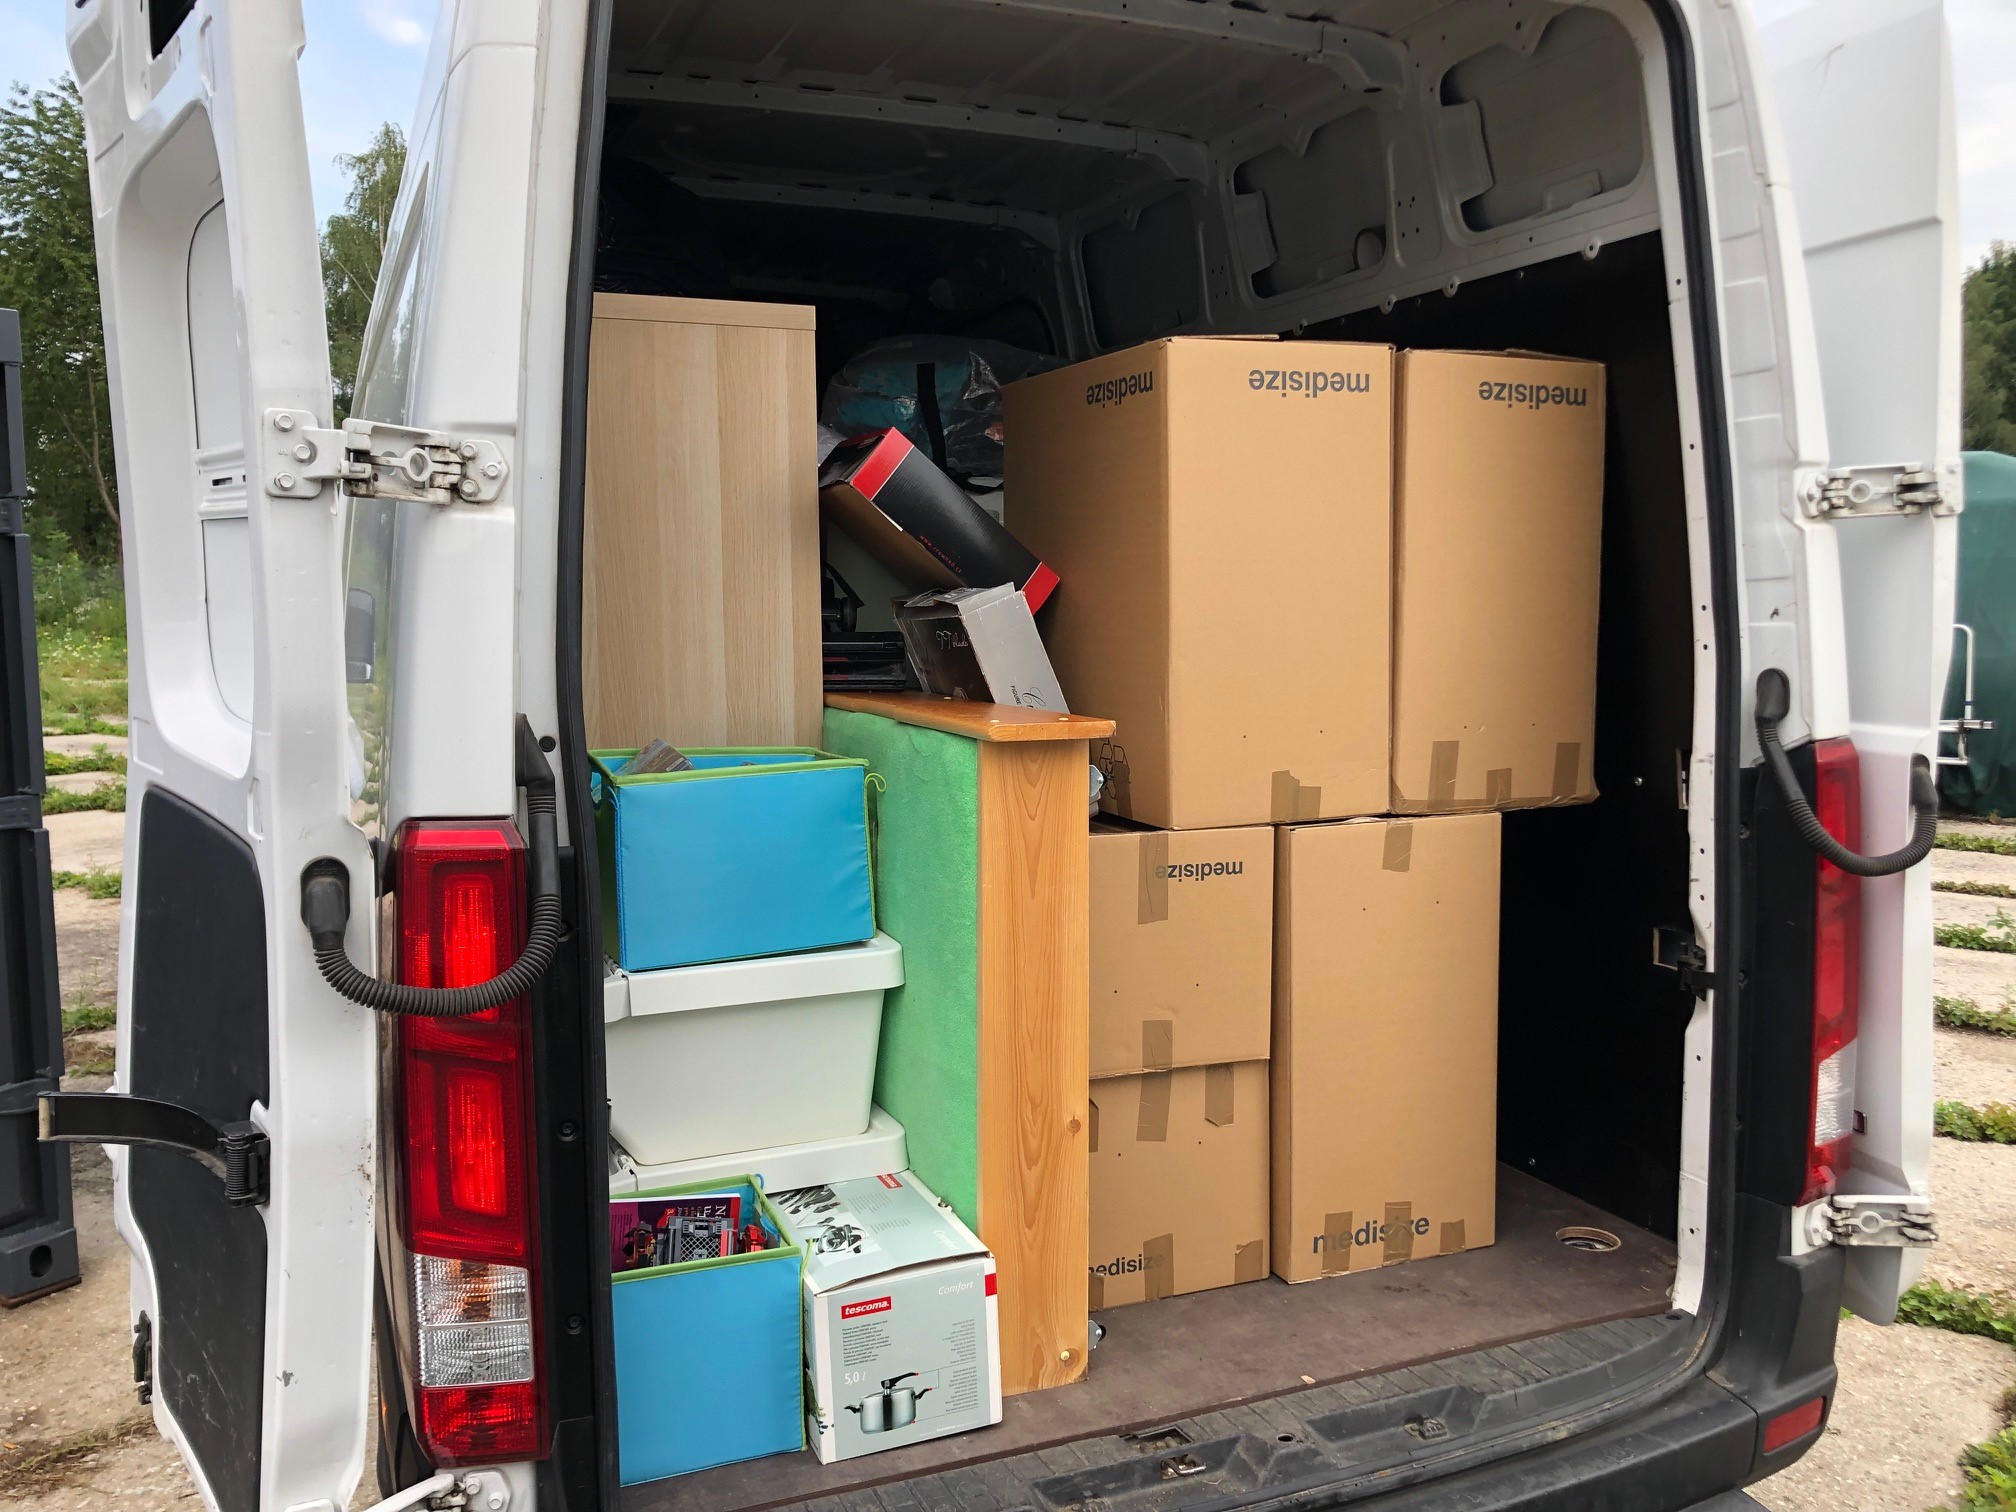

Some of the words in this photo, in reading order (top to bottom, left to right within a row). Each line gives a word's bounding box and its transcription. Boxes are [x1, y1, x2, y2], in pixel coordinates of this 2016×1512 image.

[1086, 369, 1154, 409] medisize
[1248, 369, 1370, 399] medisize
[1478, 381, 1587, 409] medisize
[1155, 861, 1244, 882] medisize
[1089, 1254, 1165, 1276] edisize
[938, 1281, 974, 1296] Comfort
[844, 1371, 860, 1386] 5,0
